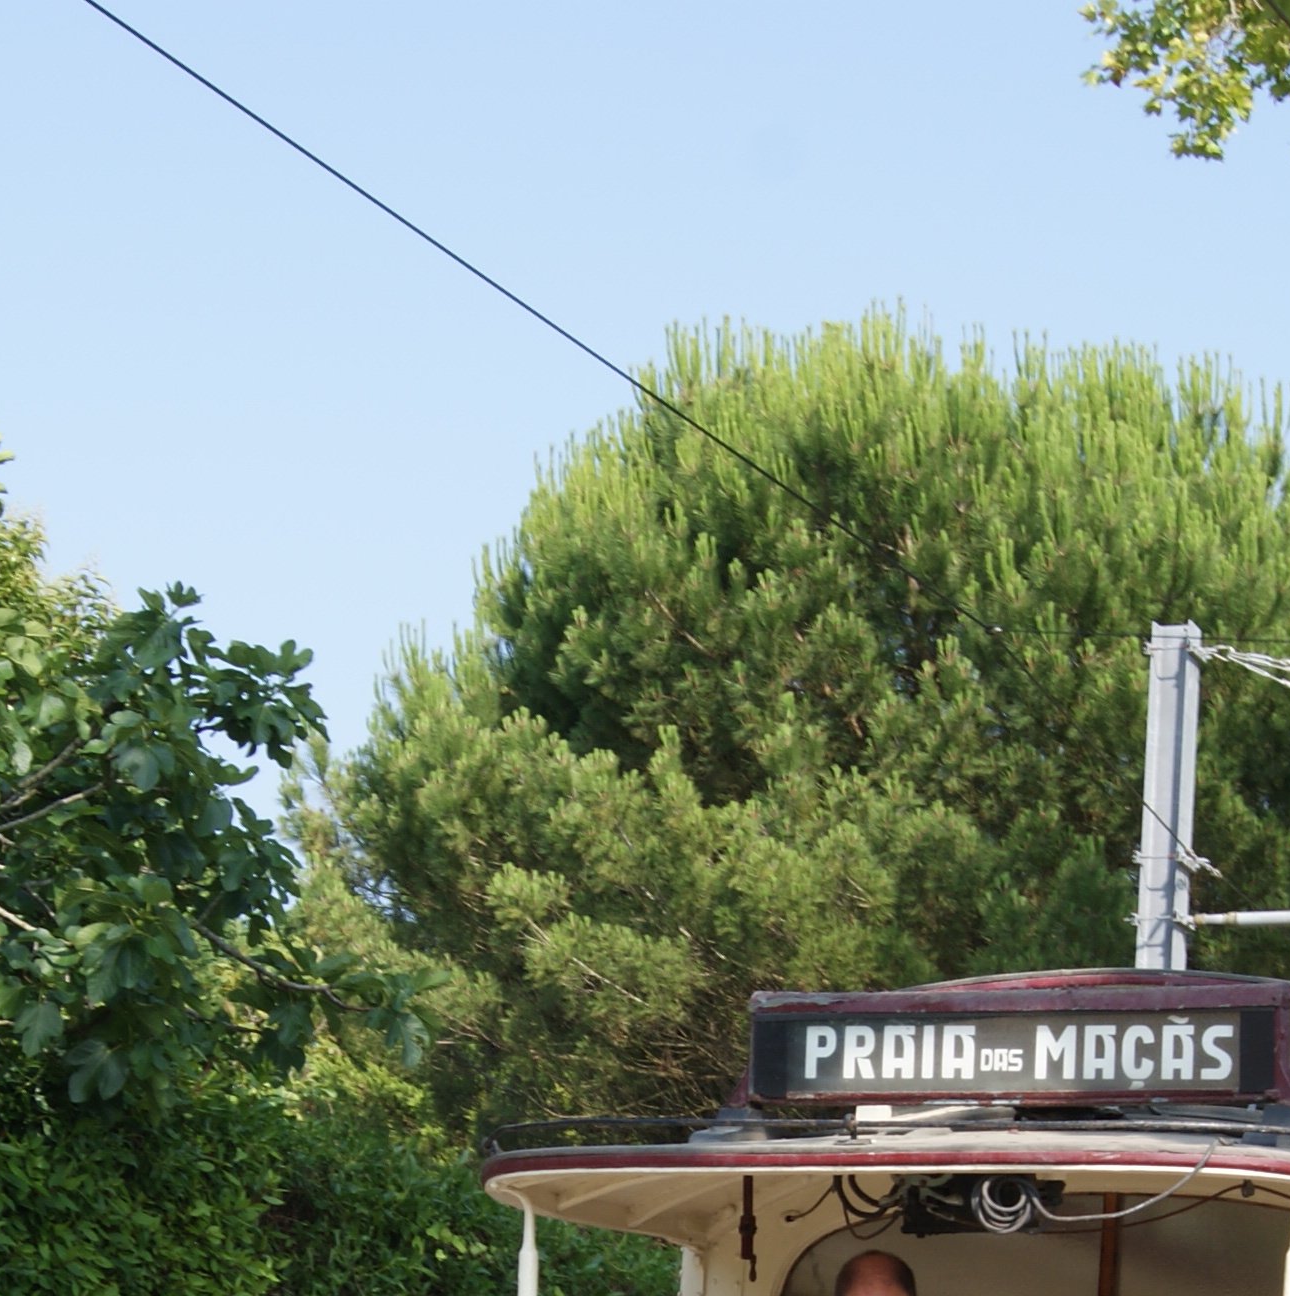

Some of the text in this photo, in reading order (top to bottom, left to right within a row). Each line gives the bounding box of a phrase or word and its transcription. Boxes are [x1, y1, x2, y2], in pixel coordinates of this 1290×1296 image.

[804, 1014, 1235, 1091] PRAIA DAS MAÇÃS
